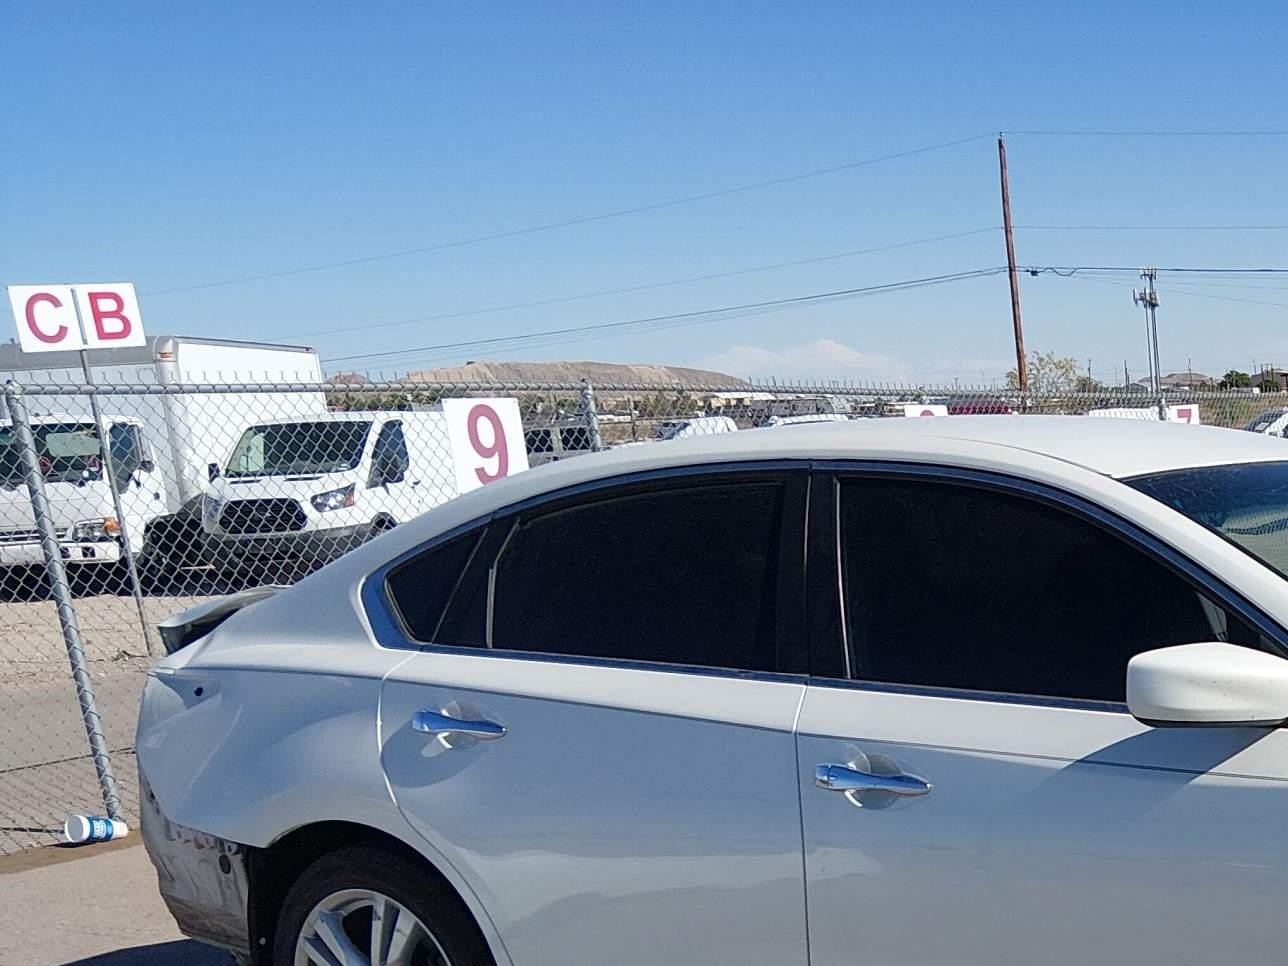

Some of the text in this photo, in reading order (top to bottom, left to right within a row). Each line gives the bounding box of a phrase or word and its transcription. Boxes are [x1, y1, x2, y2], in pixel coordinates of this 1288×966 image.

[25, 291, 133, 344] C B
[467, 404, 509, 486] 9
